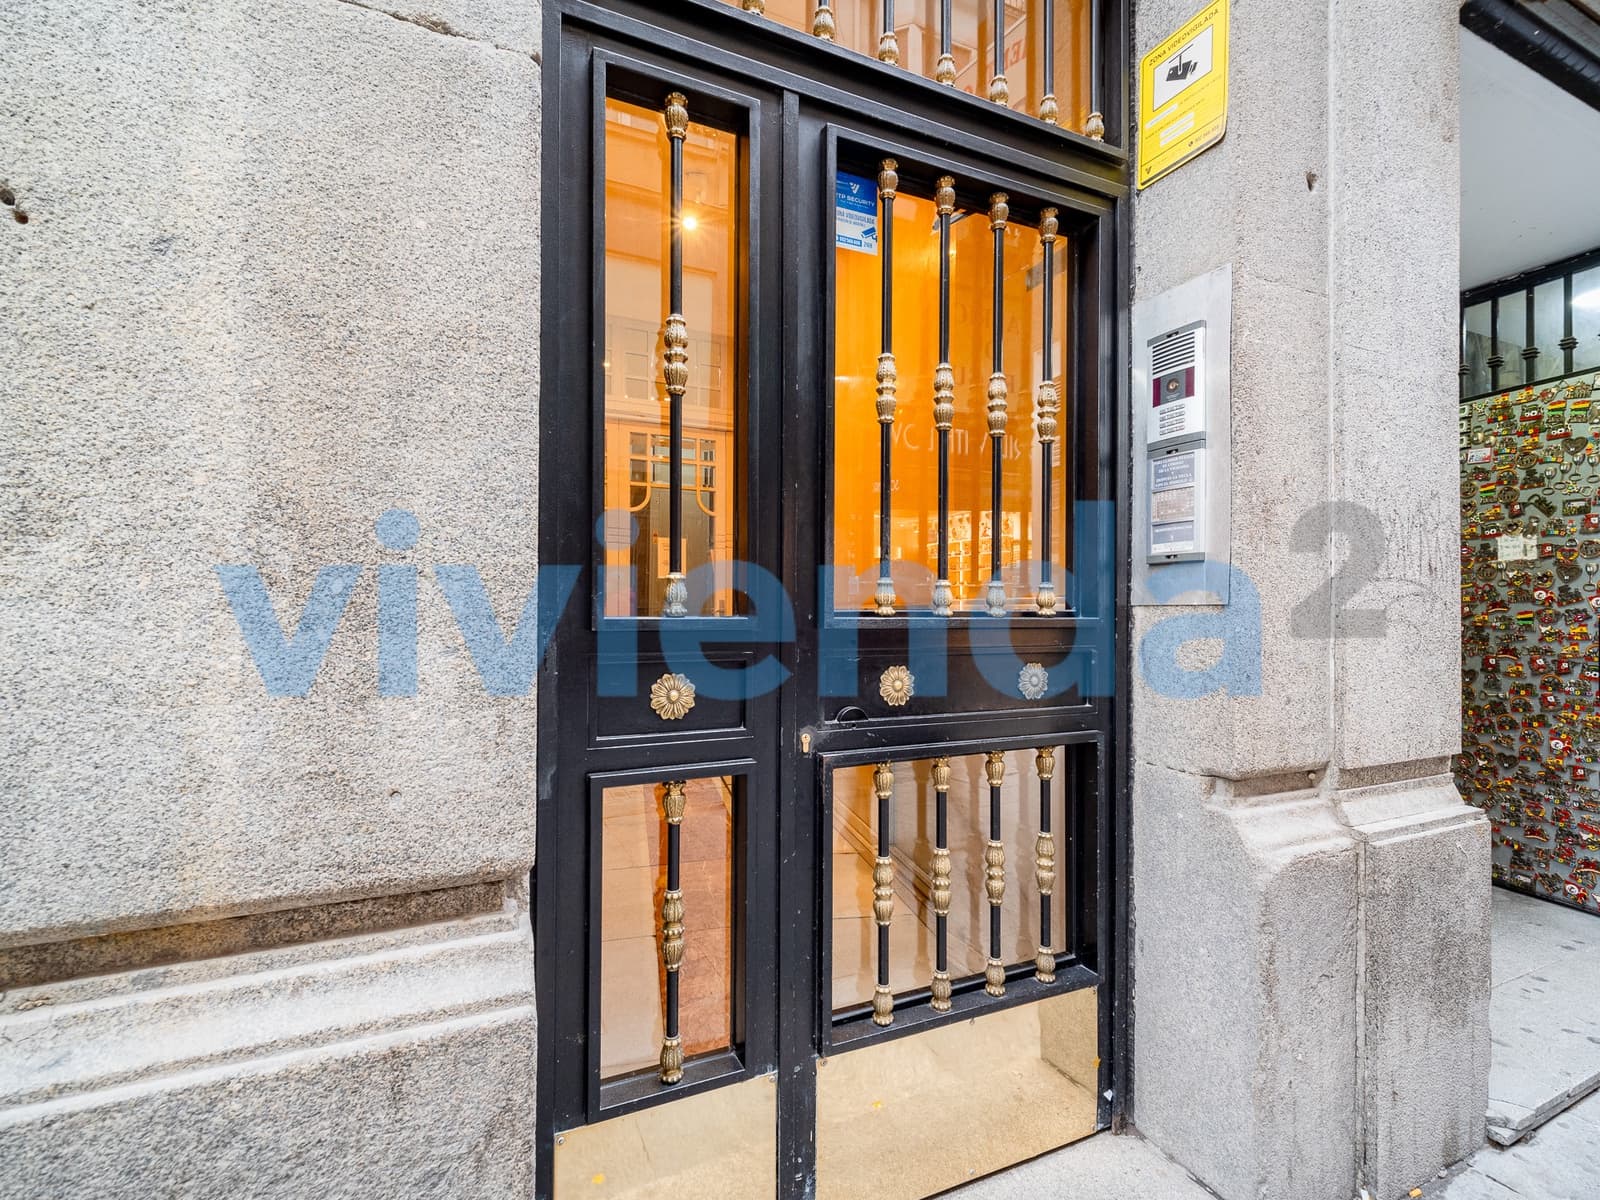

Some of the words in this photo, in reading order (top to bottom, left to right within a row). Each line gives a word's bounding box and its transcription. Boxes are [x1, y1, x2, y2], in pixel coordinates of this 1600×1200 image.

[1149, 50, 1167, 66] ZONA
[1167, 8, 1219, 52] VIDEOVIGILADA
[846, 195, 875, 207] SECURITY
